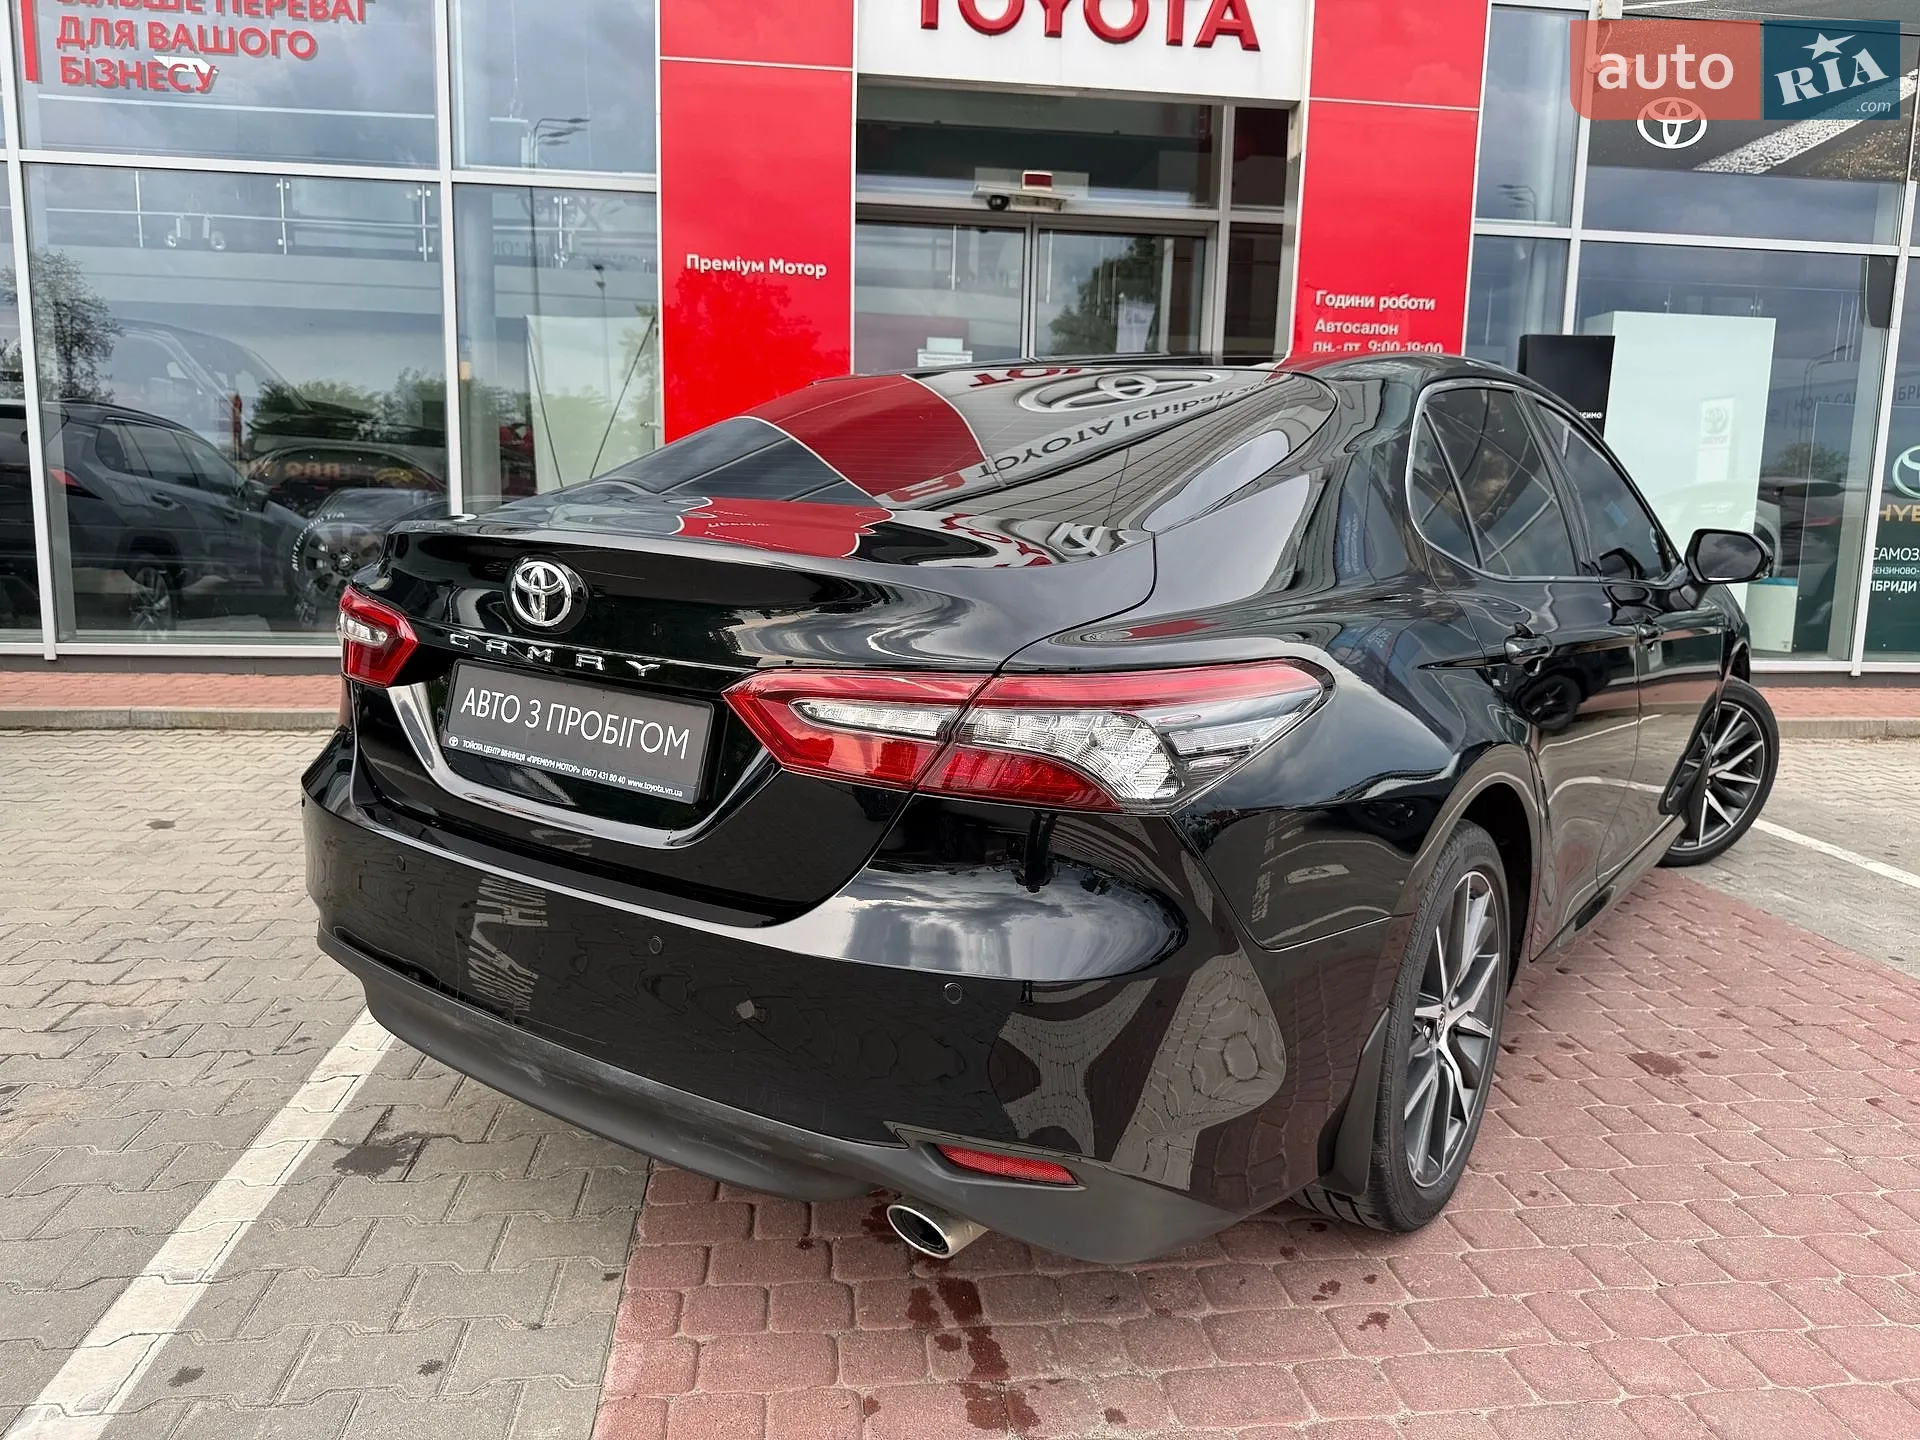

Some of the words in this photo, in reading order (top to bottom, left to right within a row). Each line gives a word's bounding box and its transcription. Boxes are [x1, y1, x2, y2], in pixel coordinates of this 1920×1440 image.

[57, 16, 137, 49] ДЛЯ
[147, 21, 317, 59] ВАШОГО
[60, 56, 216, 94] БІЗНЕСУ
[686, 253, 765, 276] Преміум
[768, 257, 828, 279] Мотор
[1315, 290, 1375, 309] Години
[1378, 294, 1436, 312] роботи
[1314, 318, 1399, 335] Автосалон
[1871, 580, 1918, 593] ІБРИДИ
[450, 633, 660, 677] CAMRY
[460, 687, 521, 723] АВТО
[524, 699, 541, 728] З
[546, 703, 690, 759] ПРОБІГОМ
[463, 740, 483, 751] ТОЙОТА
[484, 745, 501, 755] ЦЕНТР
[501, 748, 525, 761] ВІННИЦЯ
[582, 767, 598, 779] (067)
[598, 771, 609, 781] 431
[609, 773, 617, 783] 80
[617, 775, 626, 784] 40
[627, 778, 683, 797] www.toyota.vn.ua
